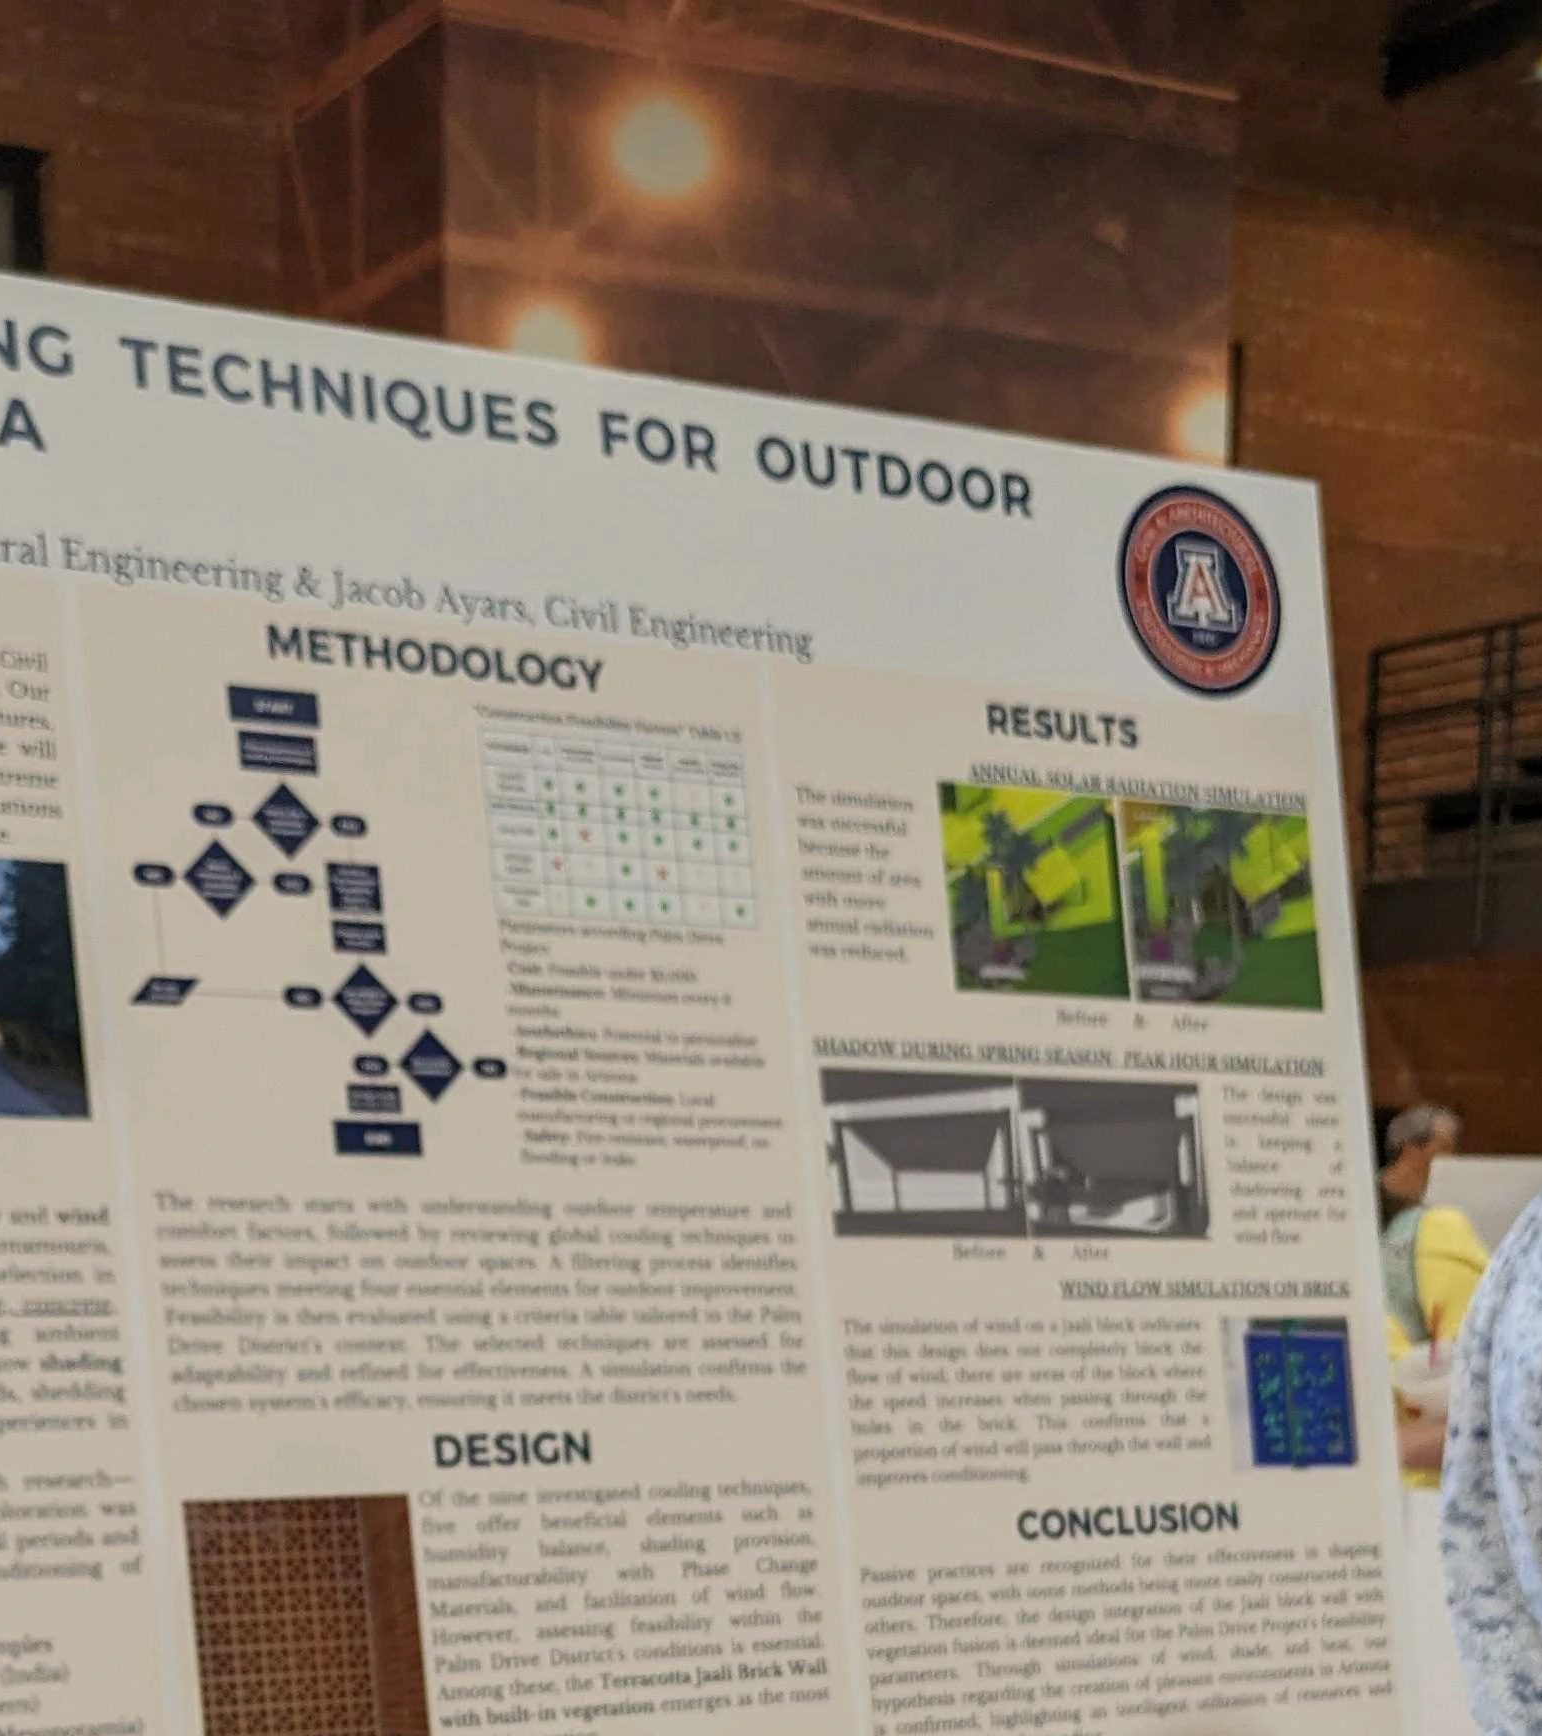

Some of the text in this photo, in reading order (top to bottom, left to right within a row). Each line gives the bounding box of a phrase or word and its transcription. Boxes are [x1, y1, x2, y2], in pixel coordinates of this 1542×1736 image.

[119, 336, 559, 448] TECHNIQUES
[599, 410, 717, 473] FOR
[755, 434, 1032, 519] OUTDOOR
[59, 536, 284, 603] Engineering
[293, 565, 320, 598] &
[331, 569, 426, 611] Jacob
[437, 583, 535, 626] Ayars,
[544, 595, 619, 634] Civil
[628, 604, 813, 665] Engineering
[267, 623, 603, 693] METHODOLOGY
[986, 701, 1139, 750] RESULTS
[433, 1430, 592, 1469] DESIGN
[1017, 1501, 1239, 1542] CONCLUSION
